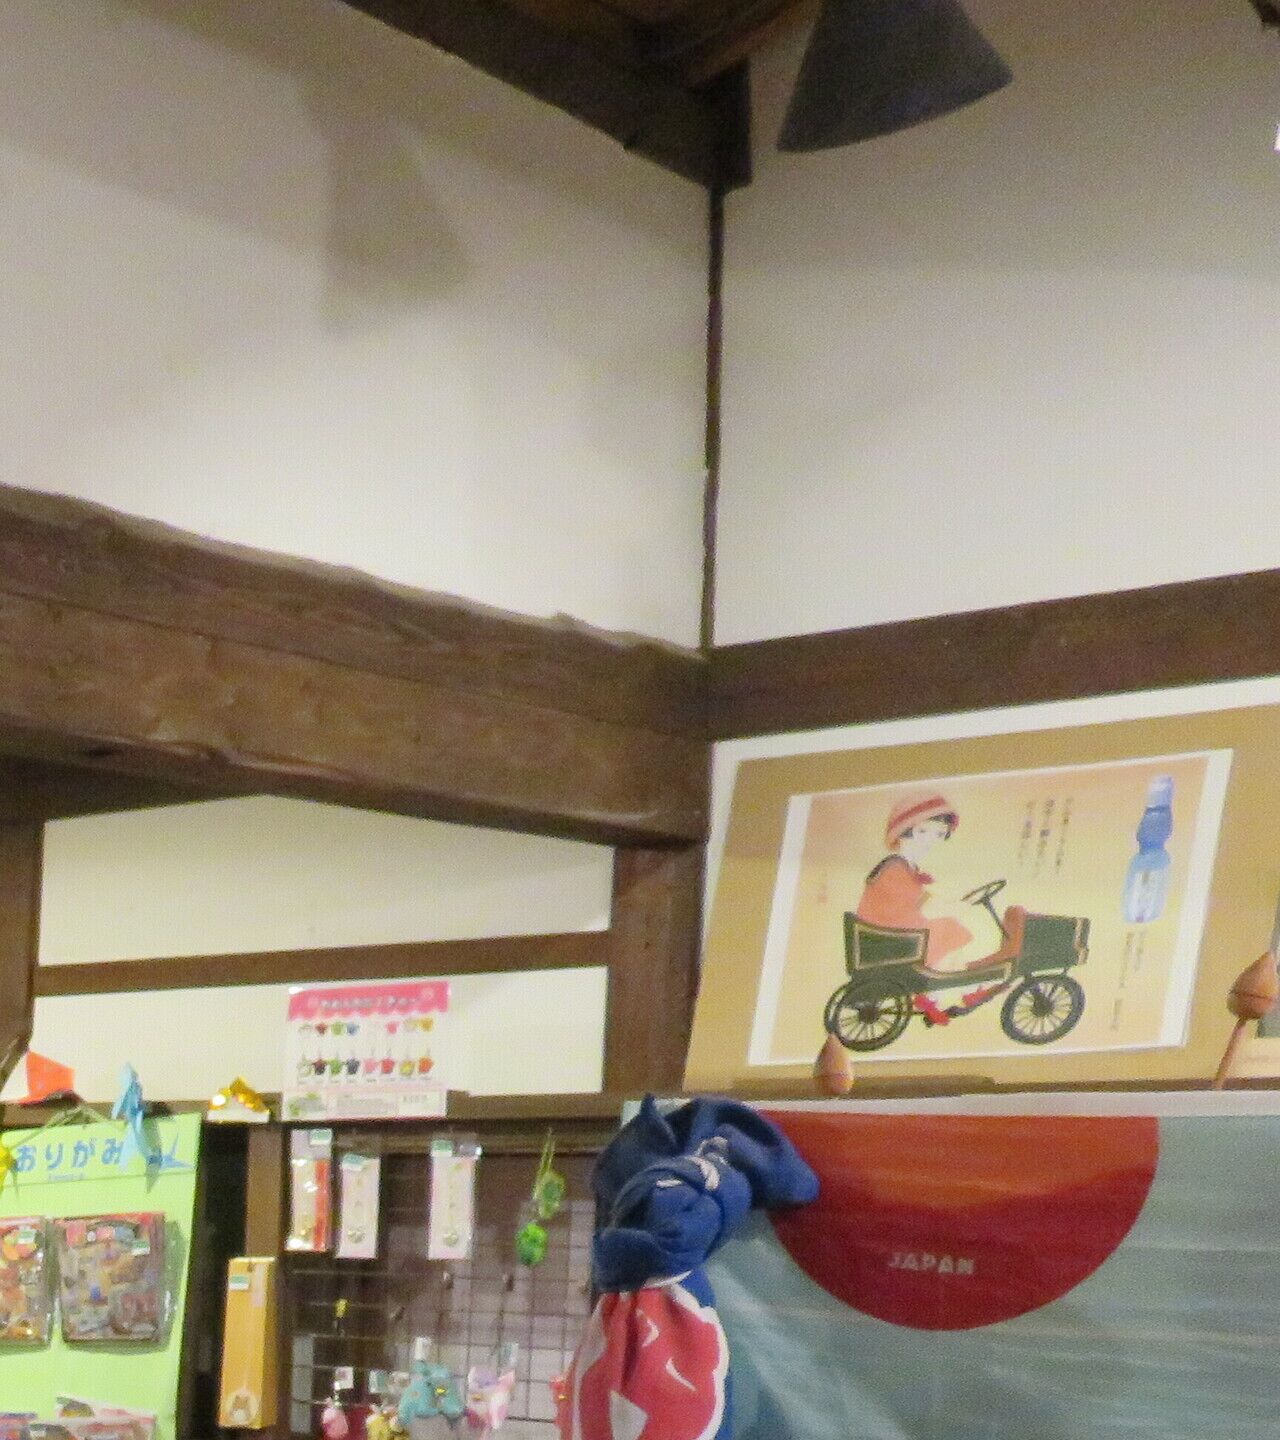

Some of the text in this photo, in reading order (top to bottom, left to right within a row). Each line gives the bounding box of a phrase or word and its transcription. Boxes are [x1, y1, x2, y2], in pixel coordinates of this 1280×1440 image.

[16, 1138, 123, 1172] おりがみ
[887, 1252, 975, 1276] JAPAN
